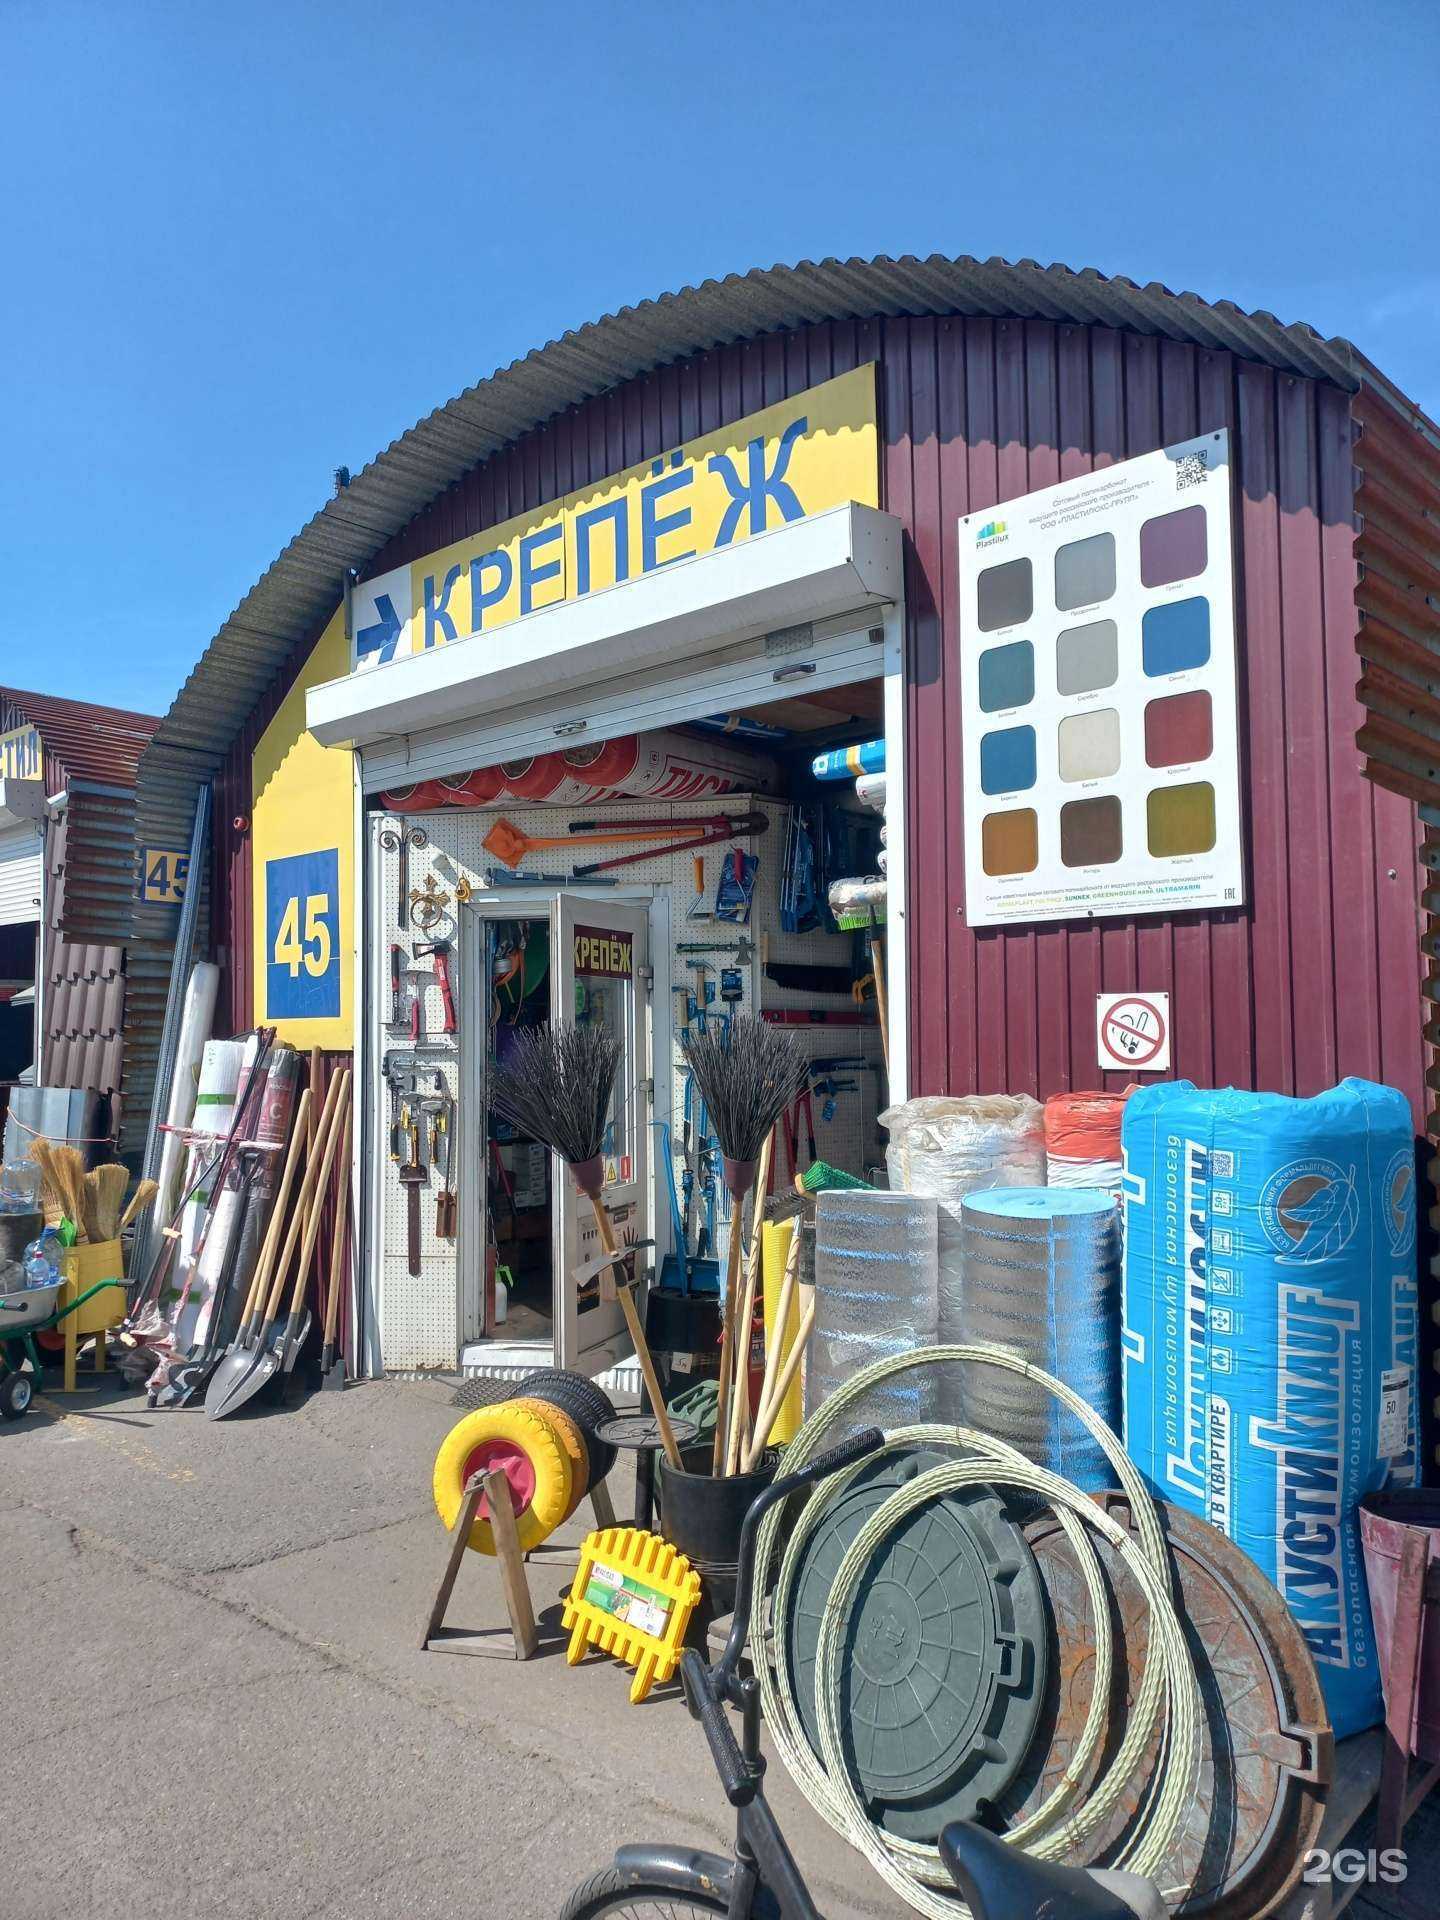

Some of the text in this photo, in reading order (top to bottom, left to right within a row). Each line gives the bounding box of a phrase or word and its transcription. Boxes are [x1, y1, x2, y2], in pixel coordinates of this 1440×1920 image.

[424, 416, 808, 649] КРЕПЁЖ
[976, 533, 1009, 550] Plastilux
[0, 729, 38, 779] ТИЛ
[147, 854, 191, 897] 45
[274, 893, 331, 978] 45
[1162, 1135, 1181, 1447] безопасная шумоизоляция
[1386, 1400, 1396, 1415] 50
[1211, 1404, 1226, 1496] КВАРТИРЕ
[1211, 1501, 1225, 1514] В
[1345, 1523, 1367, 1668] безопасная
